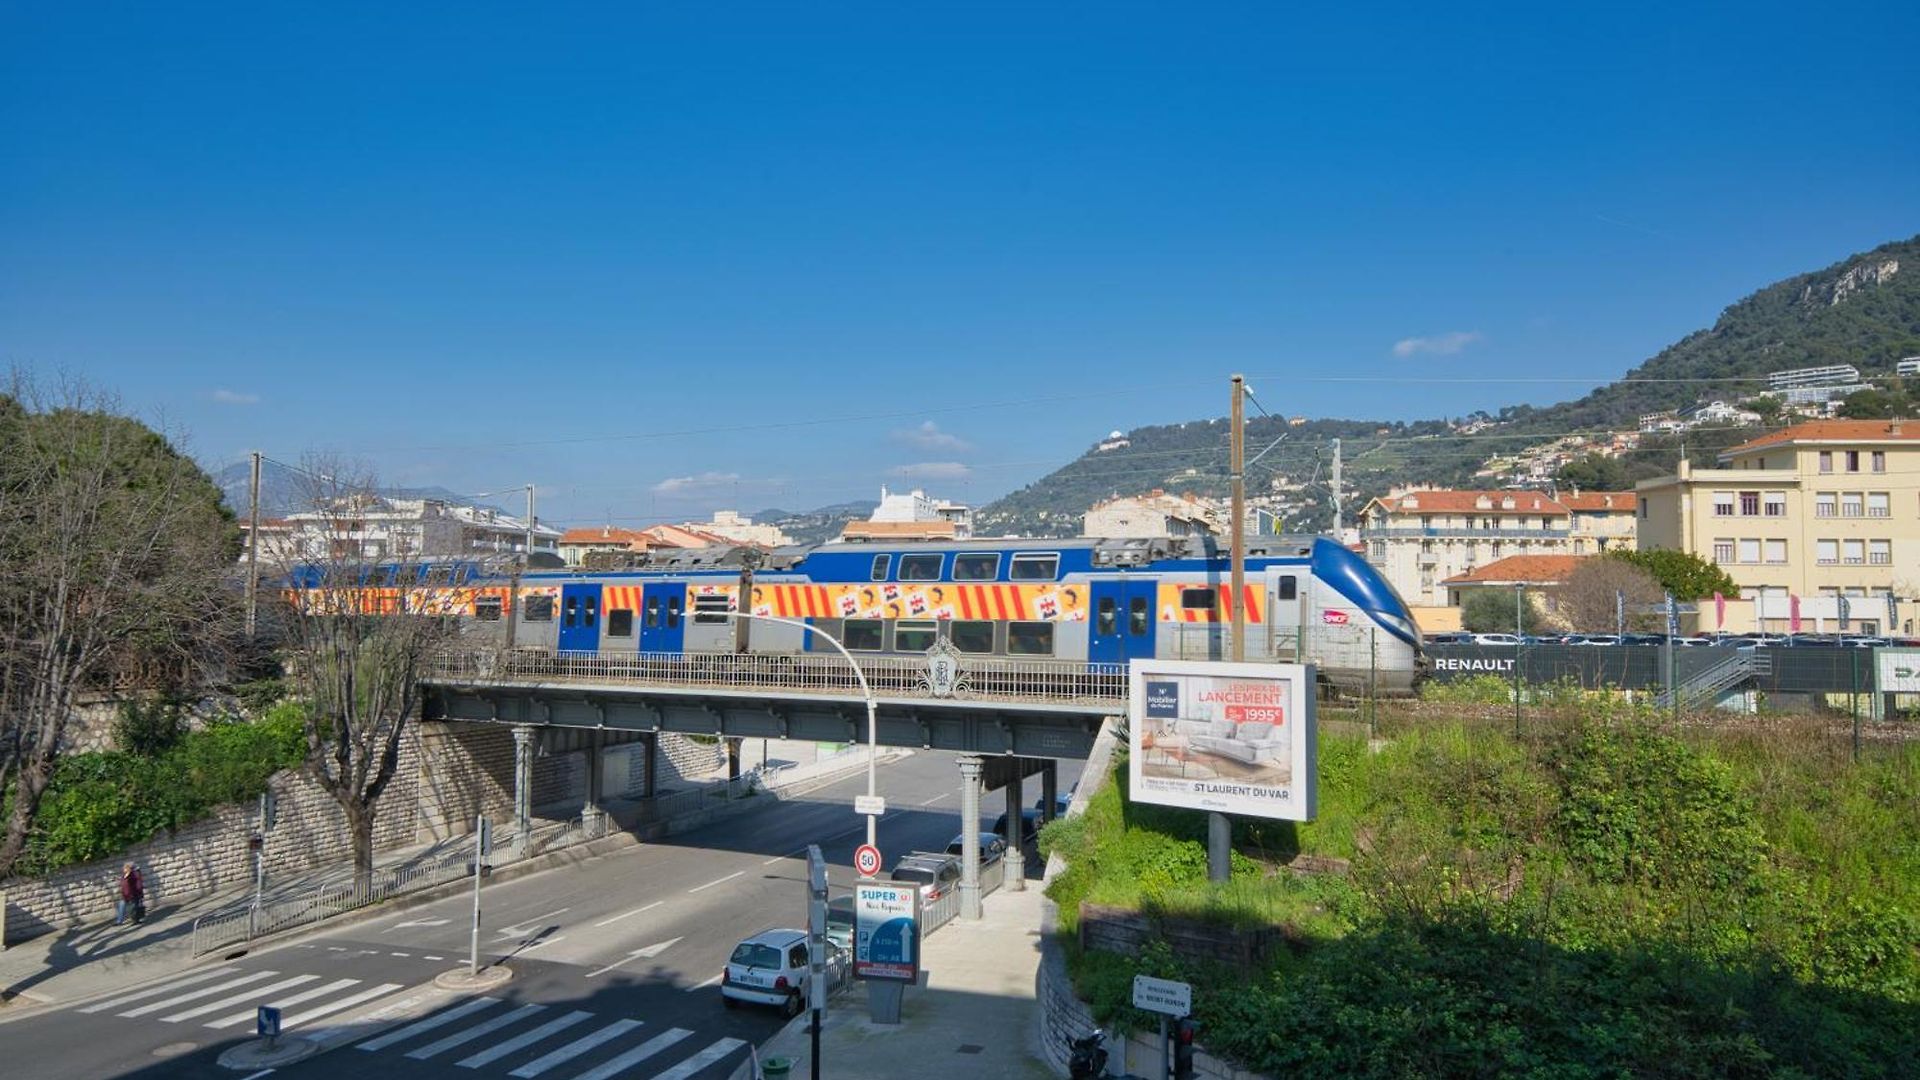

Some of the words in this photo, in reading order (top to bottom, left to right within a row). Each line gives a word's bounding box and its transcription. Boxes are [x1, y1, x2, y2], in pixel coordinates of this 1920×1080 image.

[1435, 659, 1516, 671] RENAULT
[1198, 692, 1282, 704] LANCEMENT
[1194, 783, 1206, 792] ST
[1207, 784, 1252, 796] LAURENT
[1253, 789, 1267, 797] DU
[1268, 790, 1289, 800] VAR
[862, 854, 874, 866] 50
[861, 890, 896, 901] SUPER
